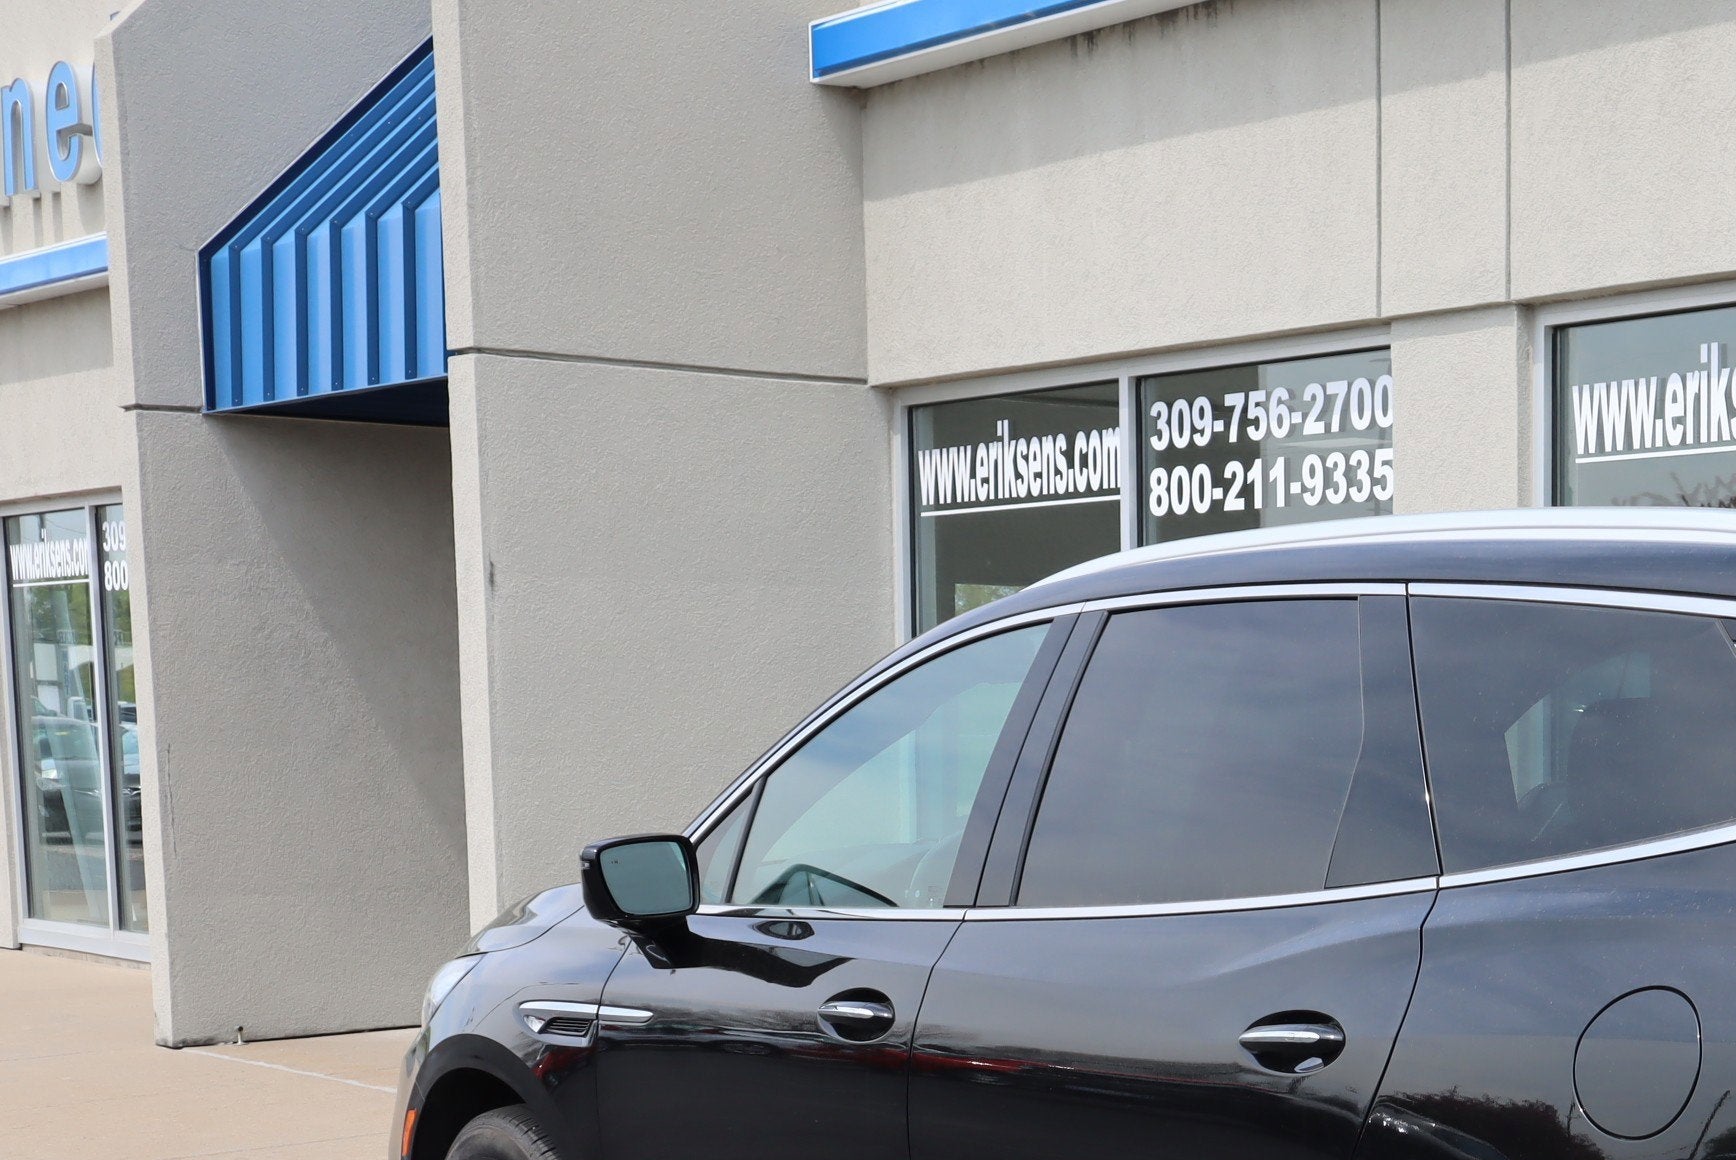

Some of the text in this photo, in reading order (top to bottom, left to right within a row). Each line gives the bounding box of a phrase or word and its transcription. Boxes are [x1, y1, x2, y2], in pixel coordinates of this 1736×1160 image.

[0, 60, 103, 196] ne
[1149, 375, 1394, 451] 309-756-2700
[918, 420, 1121, 506] www.eriksens.com
[1149, 448, 1394, 516] 800-211-9335
